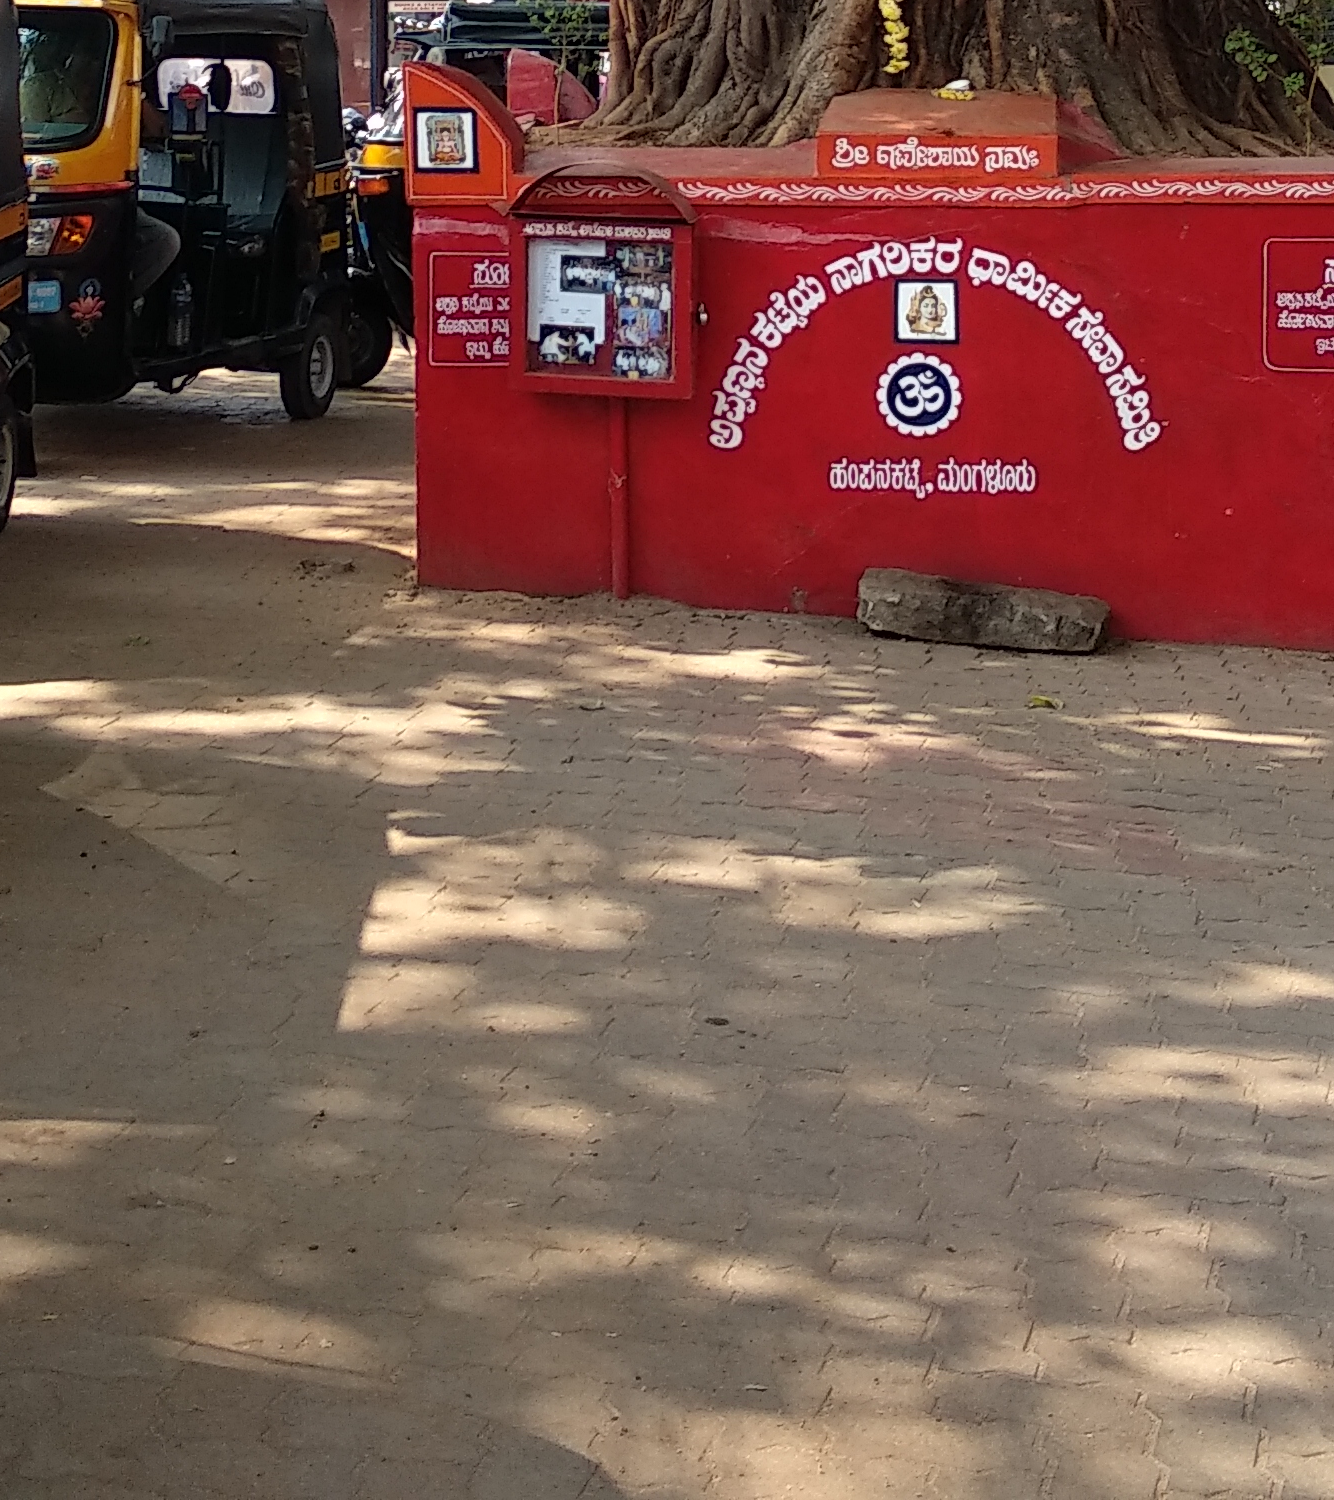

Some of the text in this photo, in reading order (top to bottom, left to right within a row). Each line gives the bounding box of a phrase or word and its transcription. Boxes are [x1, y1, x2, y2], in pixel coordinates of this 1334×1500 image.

[832, 137, 869, 168] ಶ್ರೀ
[984, 145, 1040, 172] ನಮಃ
[823, 235, 963, 295] ನಾಗರಿಕರ
[937, 456, 1036, 495] ಮಂಗಳೂರು
